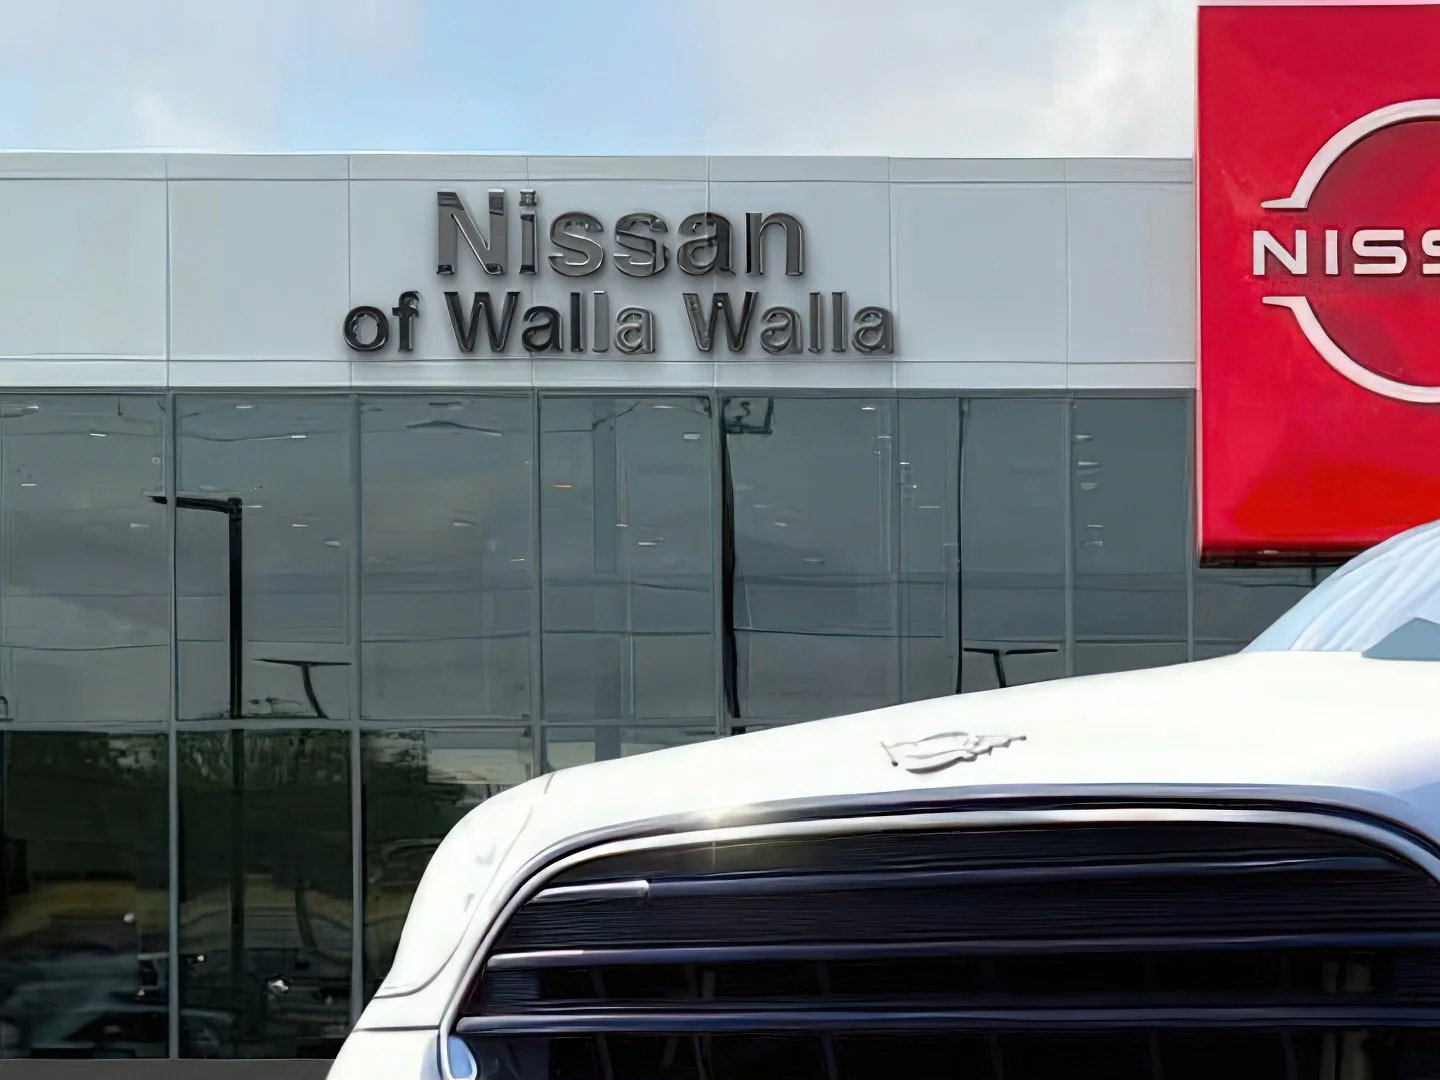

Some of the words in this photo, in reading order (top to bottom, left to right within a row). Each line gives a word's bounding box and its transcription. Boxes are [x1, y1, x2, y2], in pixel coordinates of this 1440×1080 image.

[436, 189, 804, 277] Nissan
[343, 290, 421, 353] of
[443, 290, 657, 354] Walla
[681, 290, 895, 354] Walla
